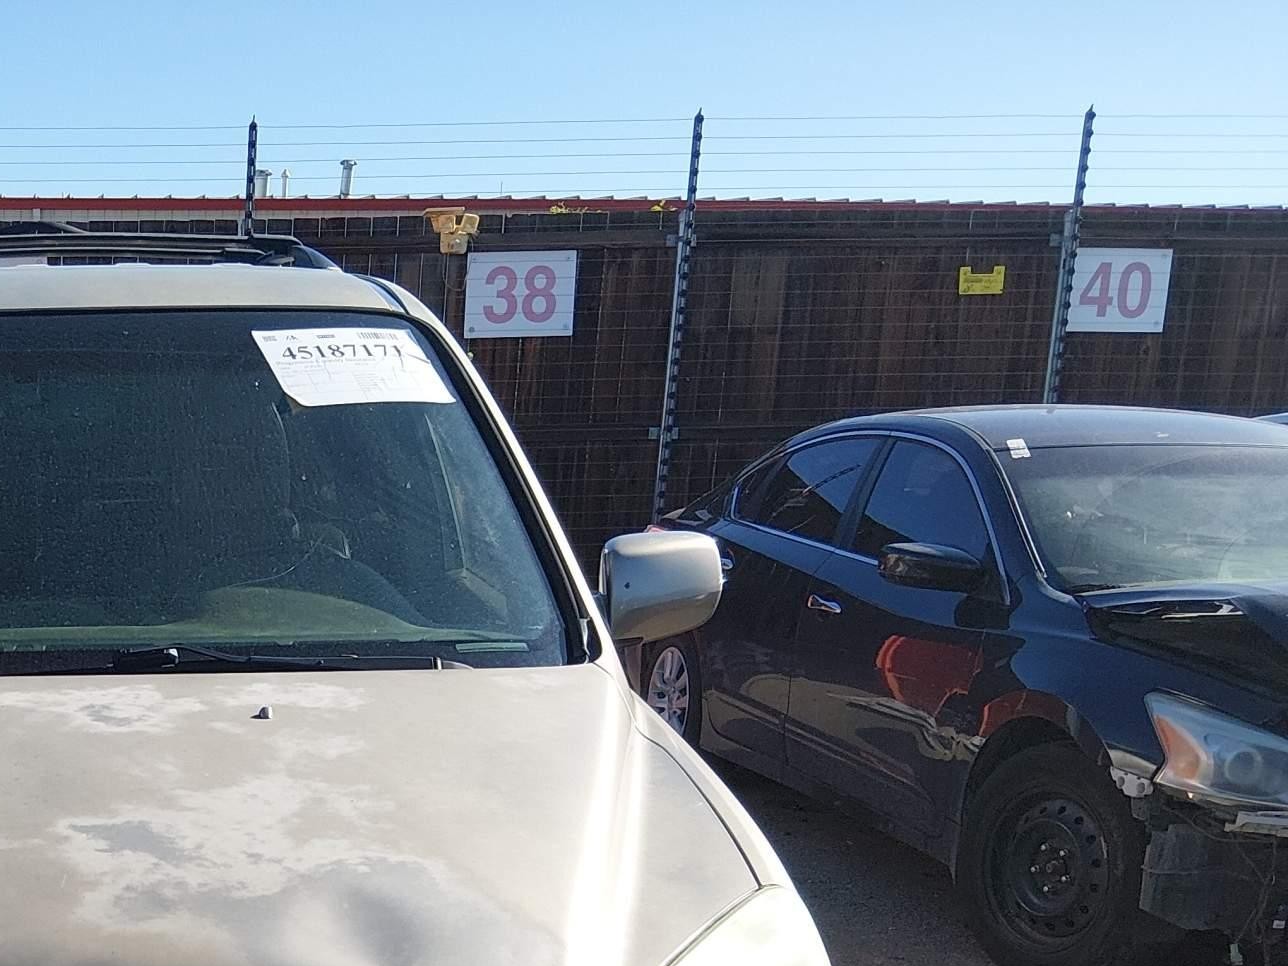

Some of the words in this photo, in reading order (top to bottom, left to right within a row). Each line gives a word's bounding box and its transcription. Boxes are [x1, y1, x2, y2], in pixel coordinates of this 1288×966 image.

[483, 265, 556, 324] 38
[1079, 261, 1152, 319] 40
[282, 344, 402, 360] 45187171
